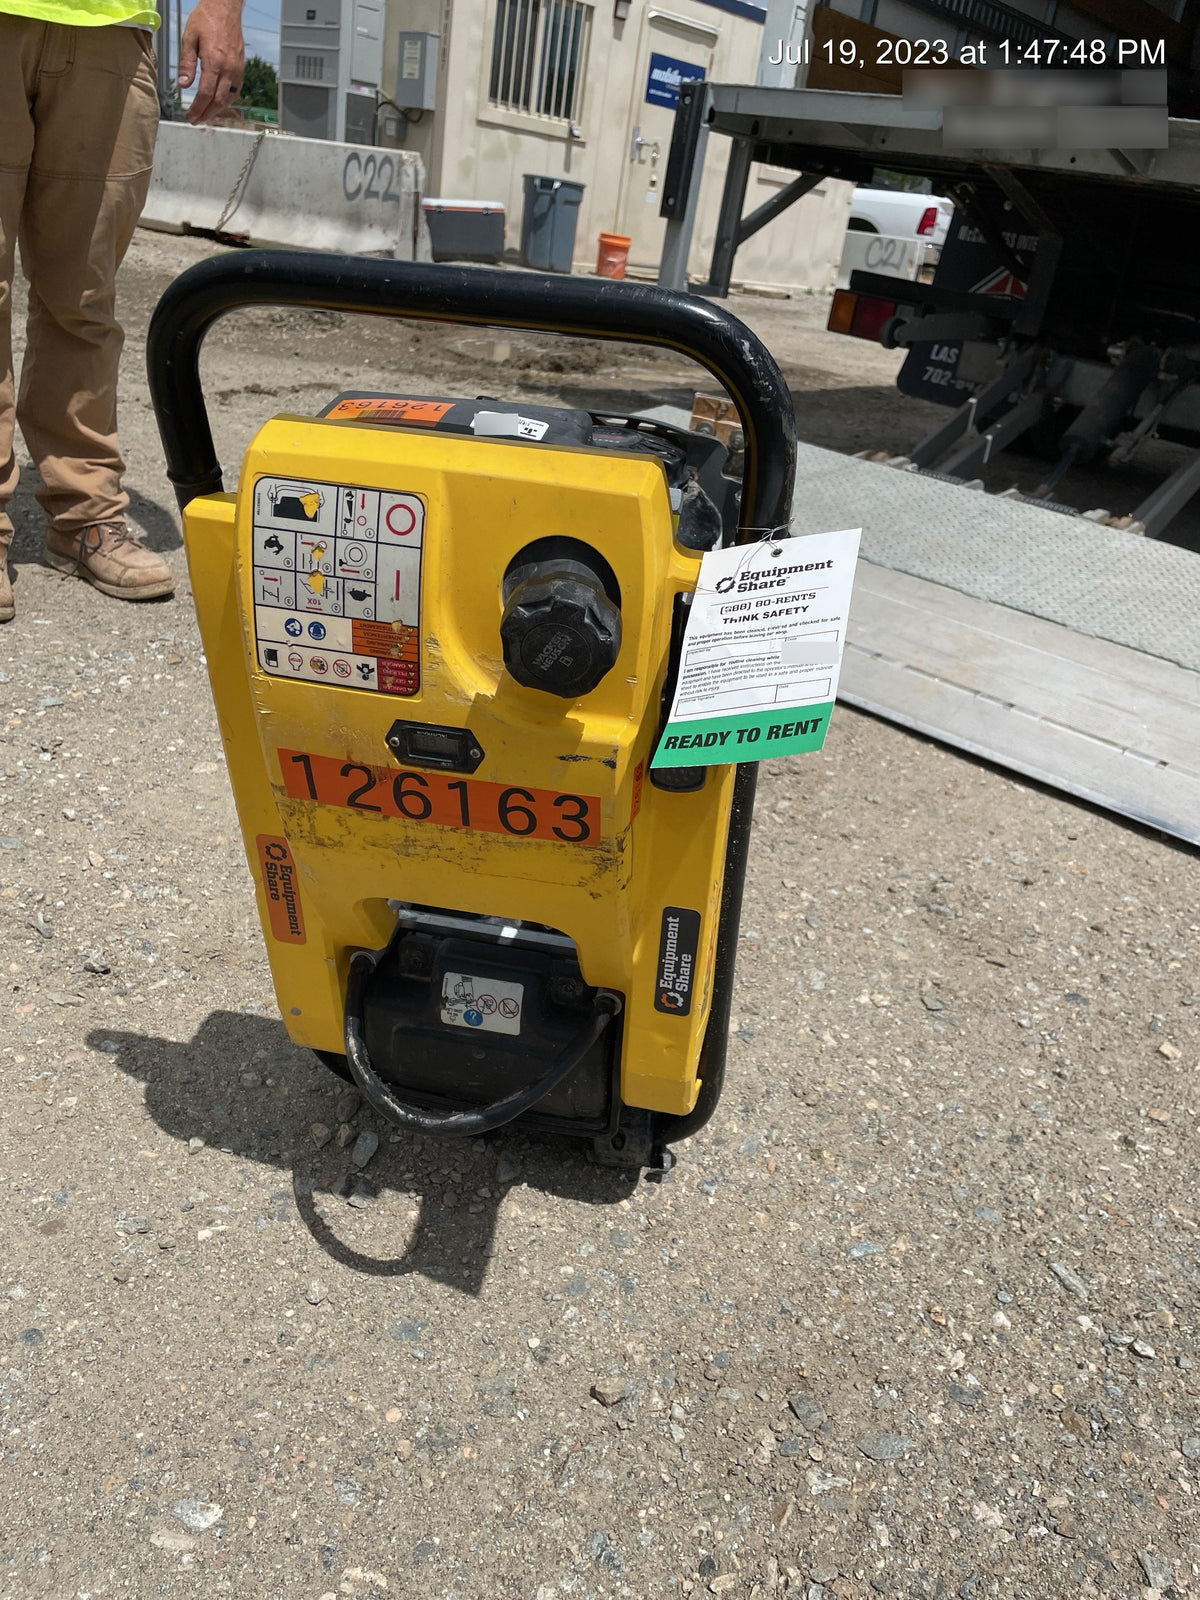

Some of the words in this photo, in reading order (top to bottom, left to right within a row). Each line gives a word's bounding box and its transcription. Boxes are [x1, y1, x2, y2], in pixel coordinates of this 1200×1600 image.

[343, 151, 400, 203] C22
[929, 343, 960, 364] LAS
[338, 400, 443, 412] 126163
[739, 559, 834, 582] Equipment
[755, 592, 817, 608] 80-RENTS
[722, 613, 760, 625] THINK
[762, 605, 809, 619] SAFETY
[699, 631, 723, 640] equipment
[799, 618, 820, 626] checked
[694, 663, 719, 672] responsible
[720, 675, 744, 684] equipment
[663, 730, 733, 750] READY
[736, 727, 763, 743] TO
[767, 717, 823, 739] RENT
[291, 753, 592, 843] 126163
[264, 861, 281, 902] Share
[279, 864, 303, 936] Equipment
[660, 916, 680, 989] Equipment
[674, 953, 693, 993] Share
